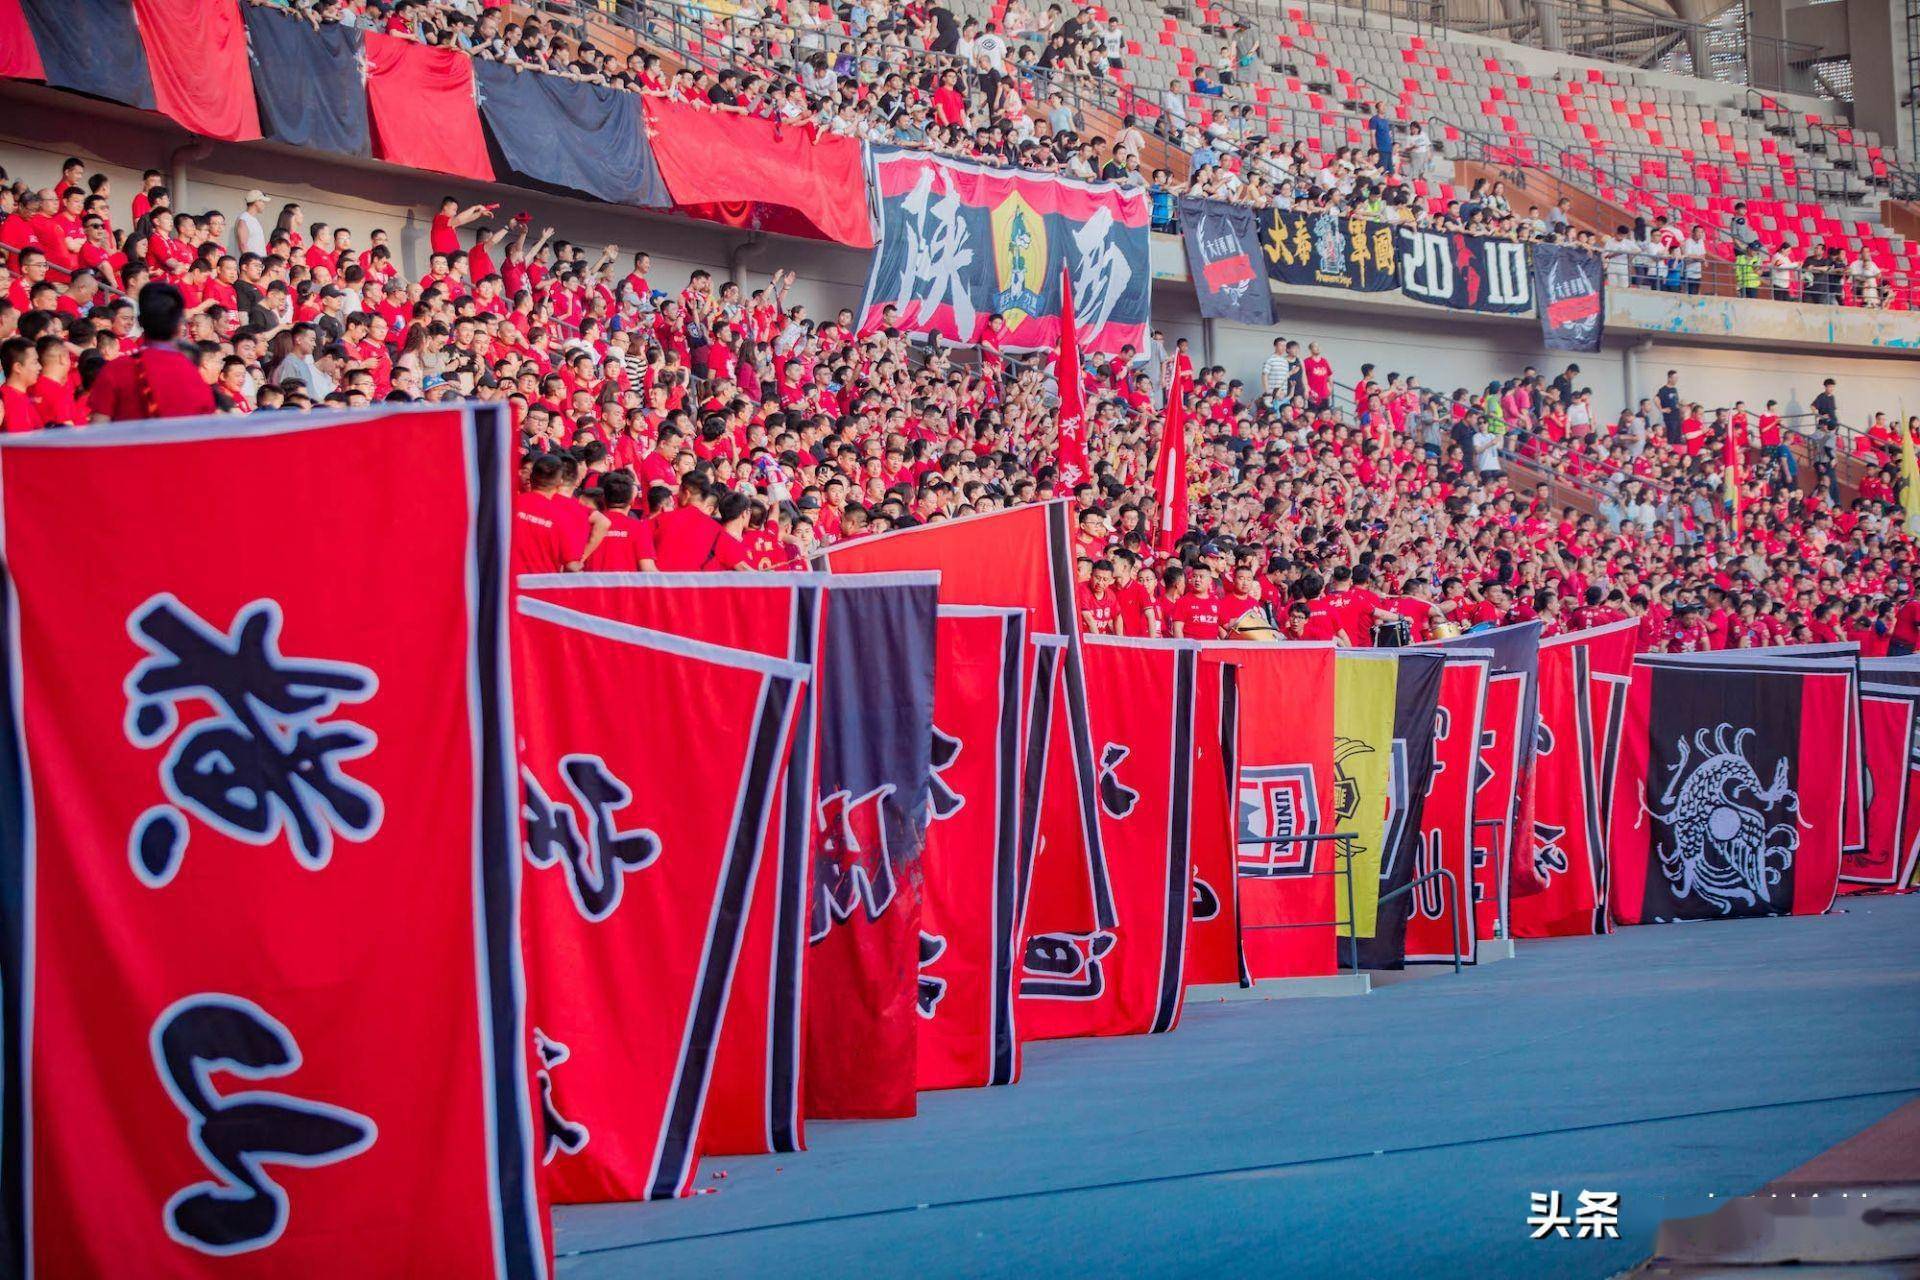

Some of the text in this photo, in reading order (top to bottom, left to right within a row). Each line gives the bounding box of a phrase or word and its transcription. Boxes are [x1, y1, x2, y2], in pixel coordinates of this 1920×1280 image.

[1399, 228, 1529, 304] 20 10
[1274, 790, 1293, 853] UNION
